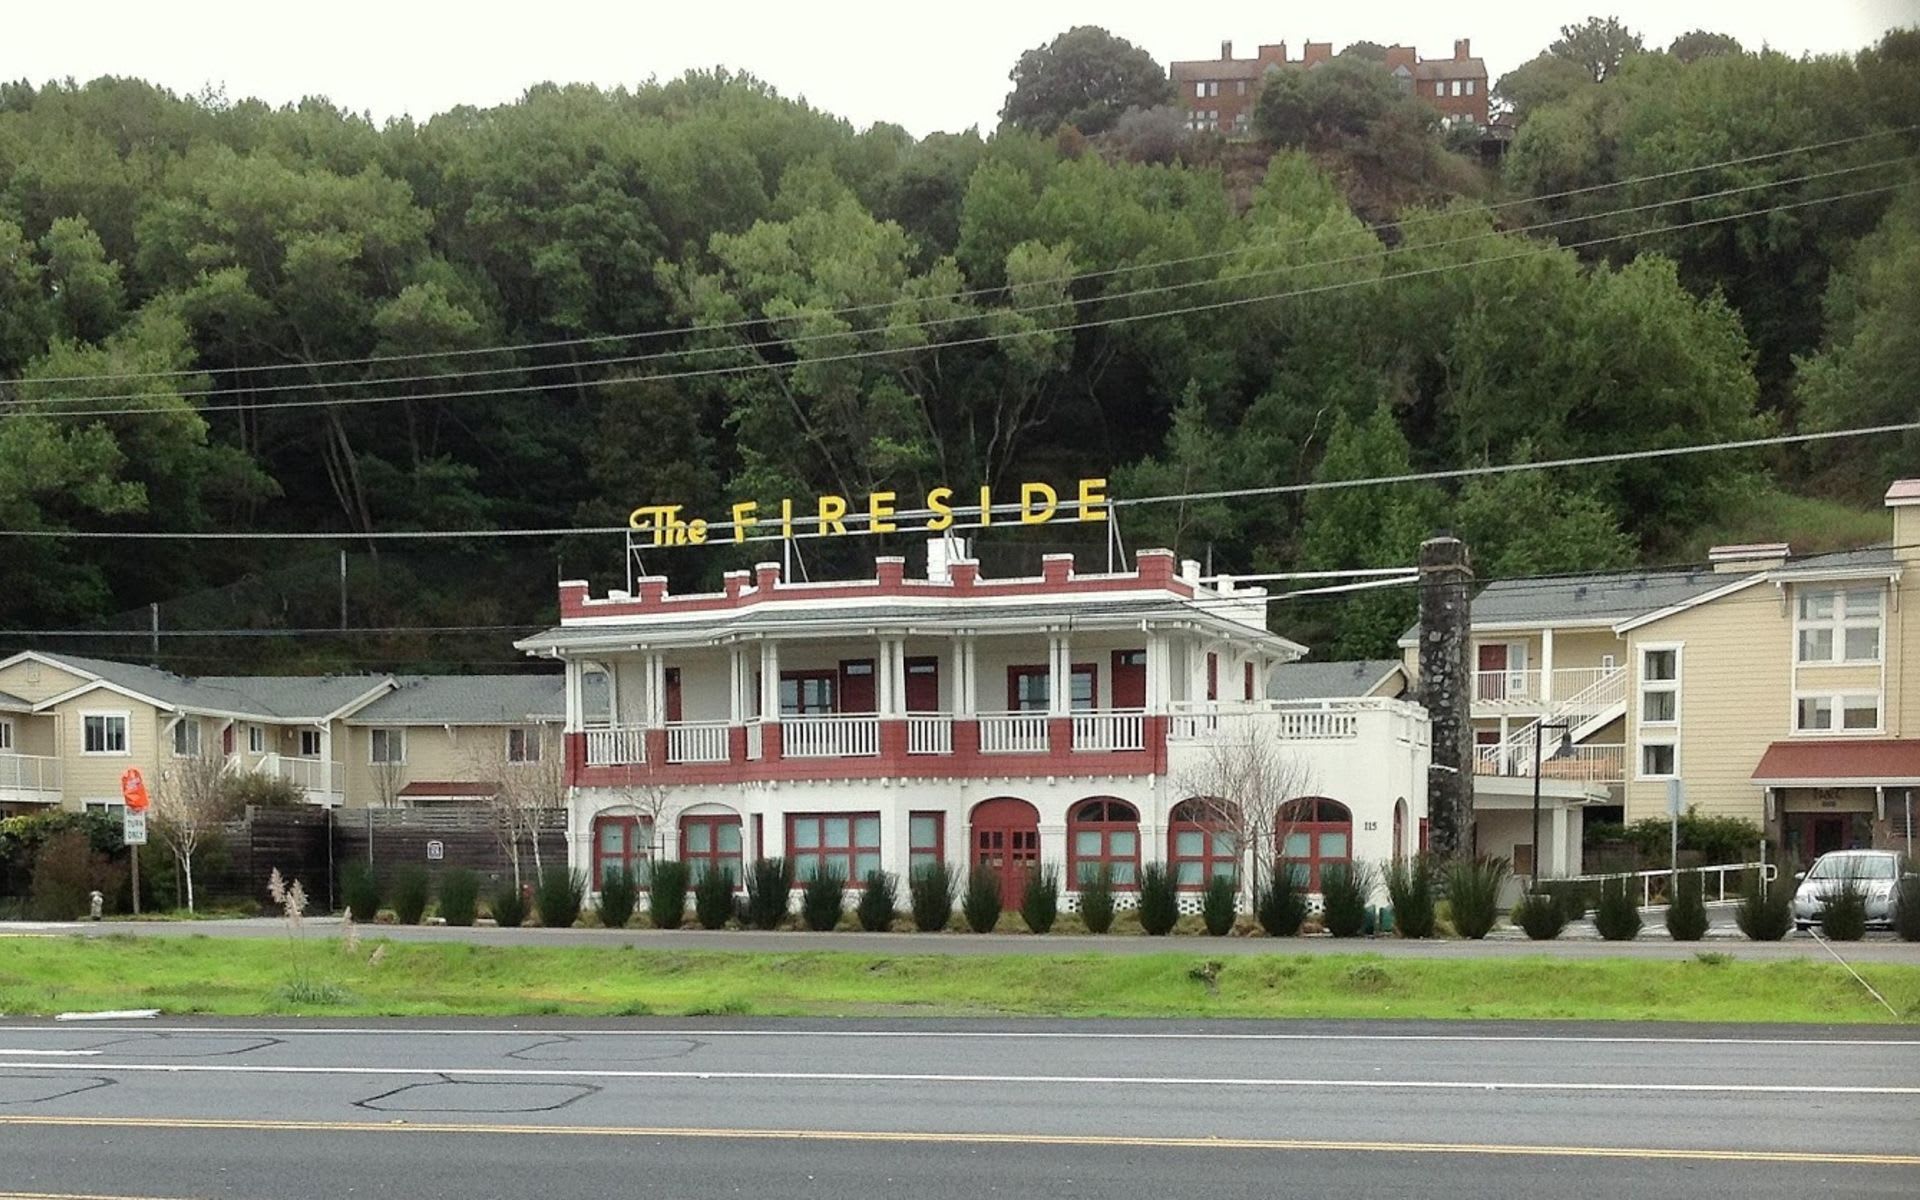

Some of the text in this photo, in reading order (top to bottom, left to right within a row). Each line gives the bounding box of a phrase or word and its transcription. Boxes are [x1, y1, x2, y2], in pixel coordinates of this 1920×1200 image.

[629, 479, 1107, 546] The FIRESIDE
[127, 819, 144, 828] TURN
[1364, 821, 1378, 831] 115
[127, 831, 143, 840] ONLY
